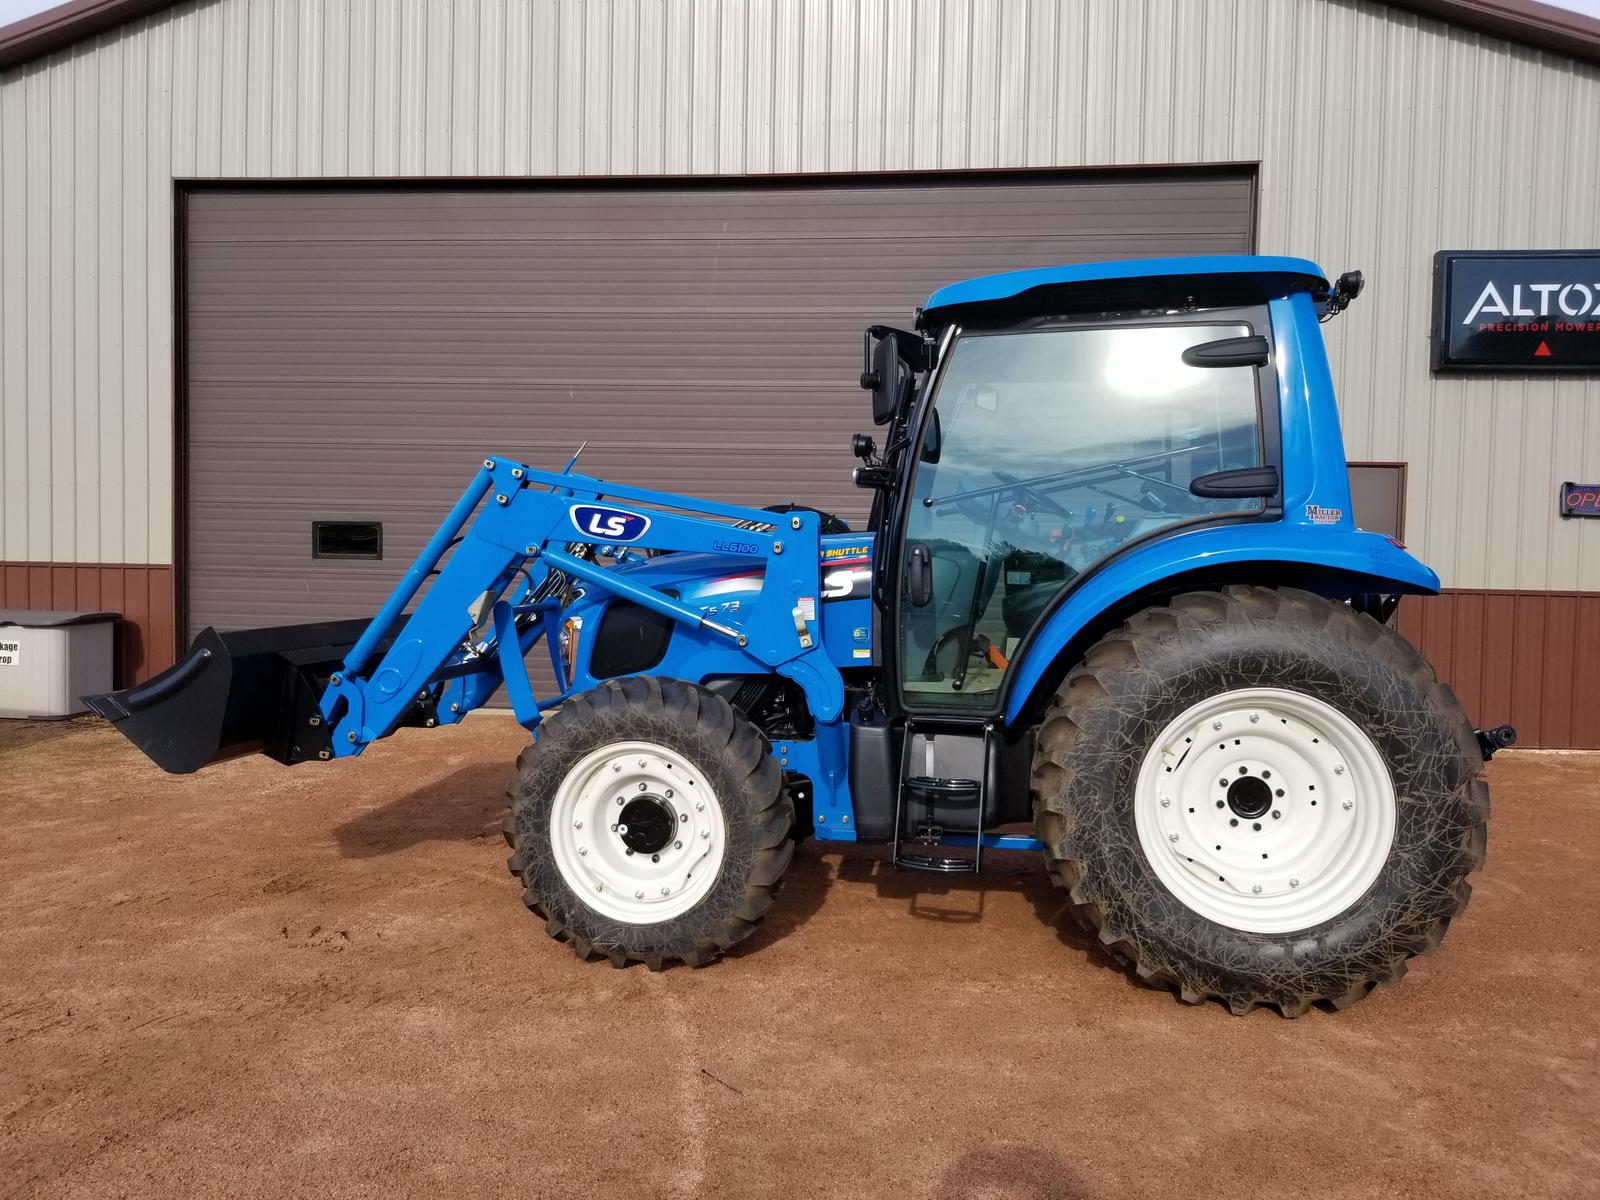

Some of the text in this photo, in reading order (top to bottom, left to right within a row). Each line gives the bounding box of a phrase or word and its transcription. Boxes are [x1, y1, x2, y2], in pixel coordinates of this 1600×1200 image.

[1479, 322, 1549, 332] PRECISION
[589, 513, 627, 536] LS
[826, 546, 869, 557] SHUTTLE
[720, 600, 740, 614] 73
